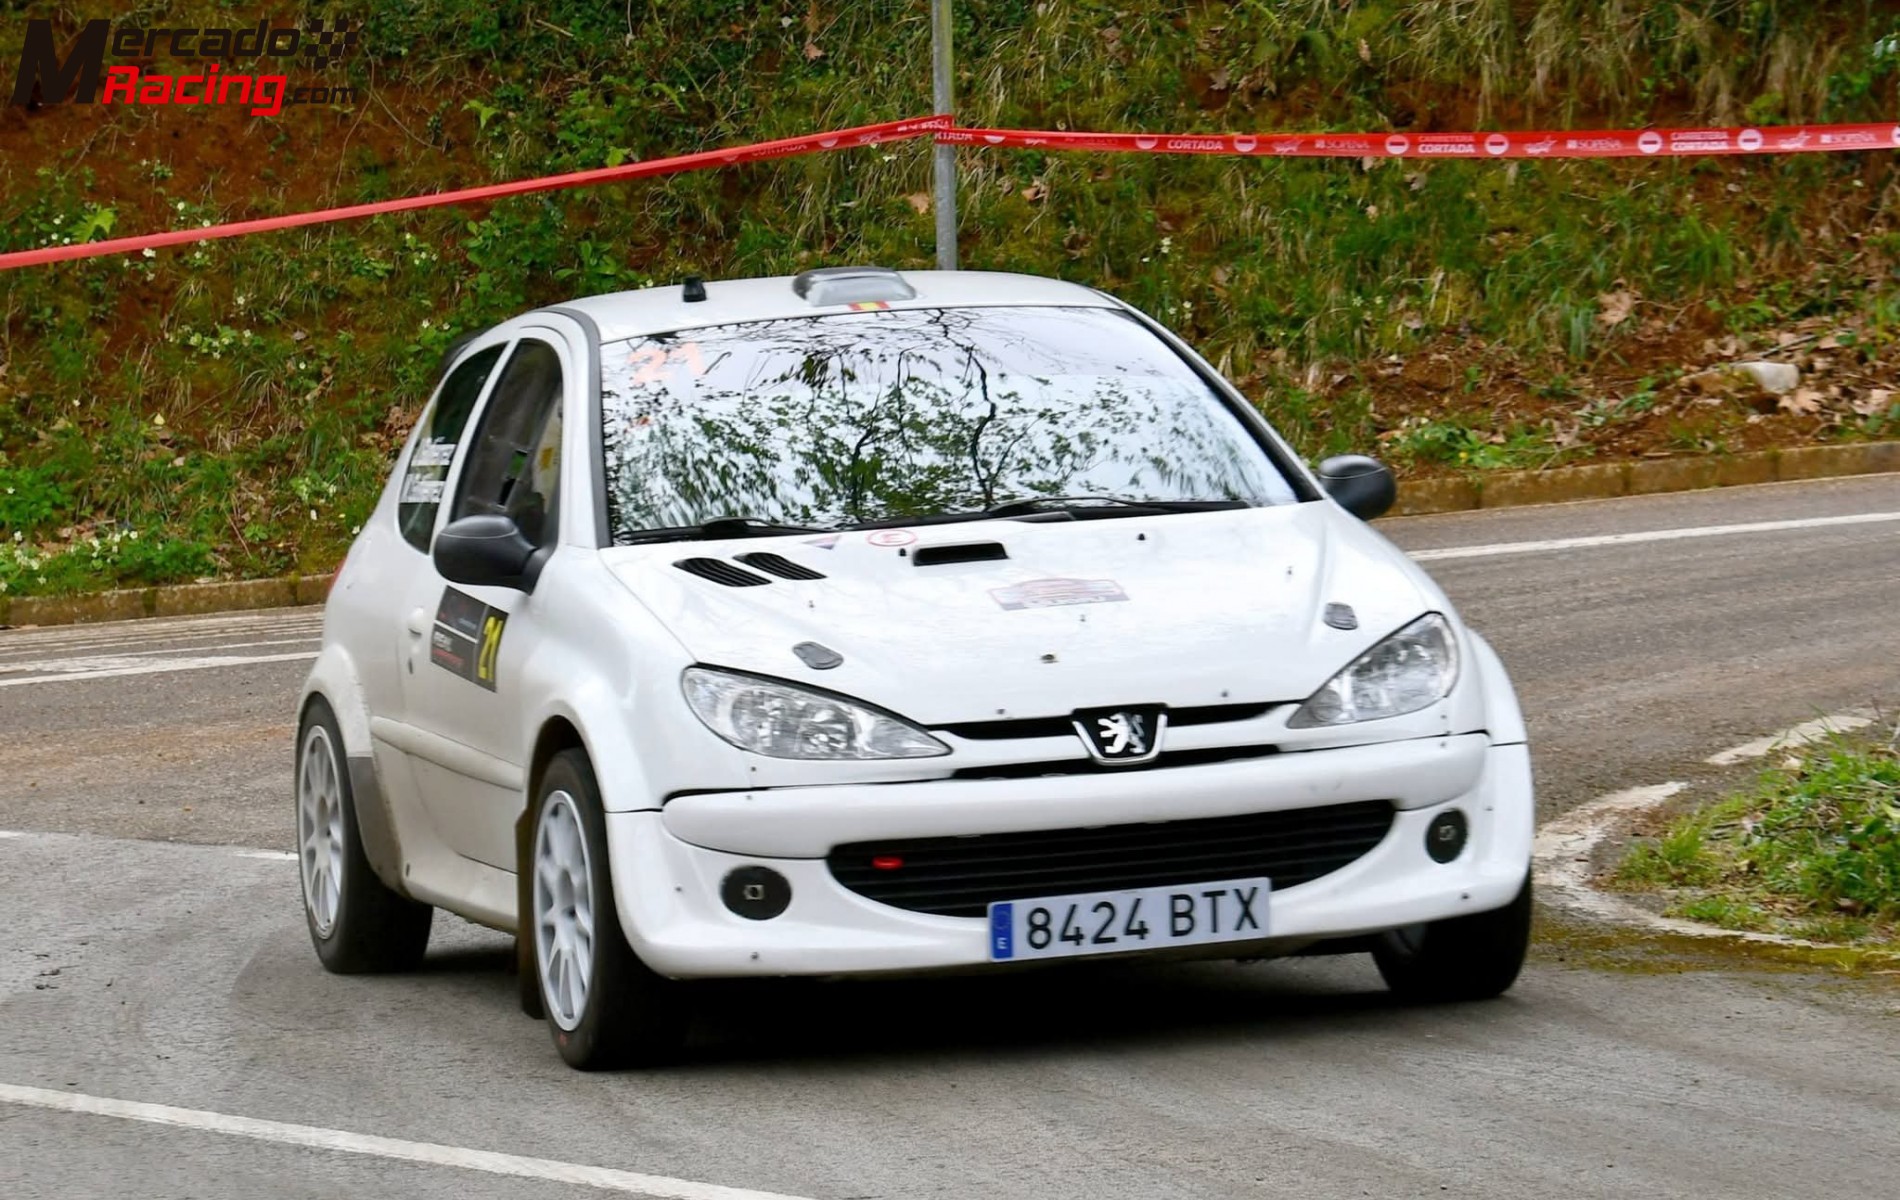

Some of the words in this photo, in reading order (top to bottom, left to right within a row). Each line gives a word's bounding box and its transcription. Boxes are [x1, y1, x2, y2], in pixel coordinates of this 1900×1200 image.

[1167, 139, 1224, 151] CORTADA
[1417, 144, 1475, 153] CORTADA
[627, 342, 703, 384] 21
[478, 616, 504, 681] 21
[996, 937, 1008, 949] E
[1027, 898, 1149, 950] 8424
[1169, 886, 1260, 937] BTX
